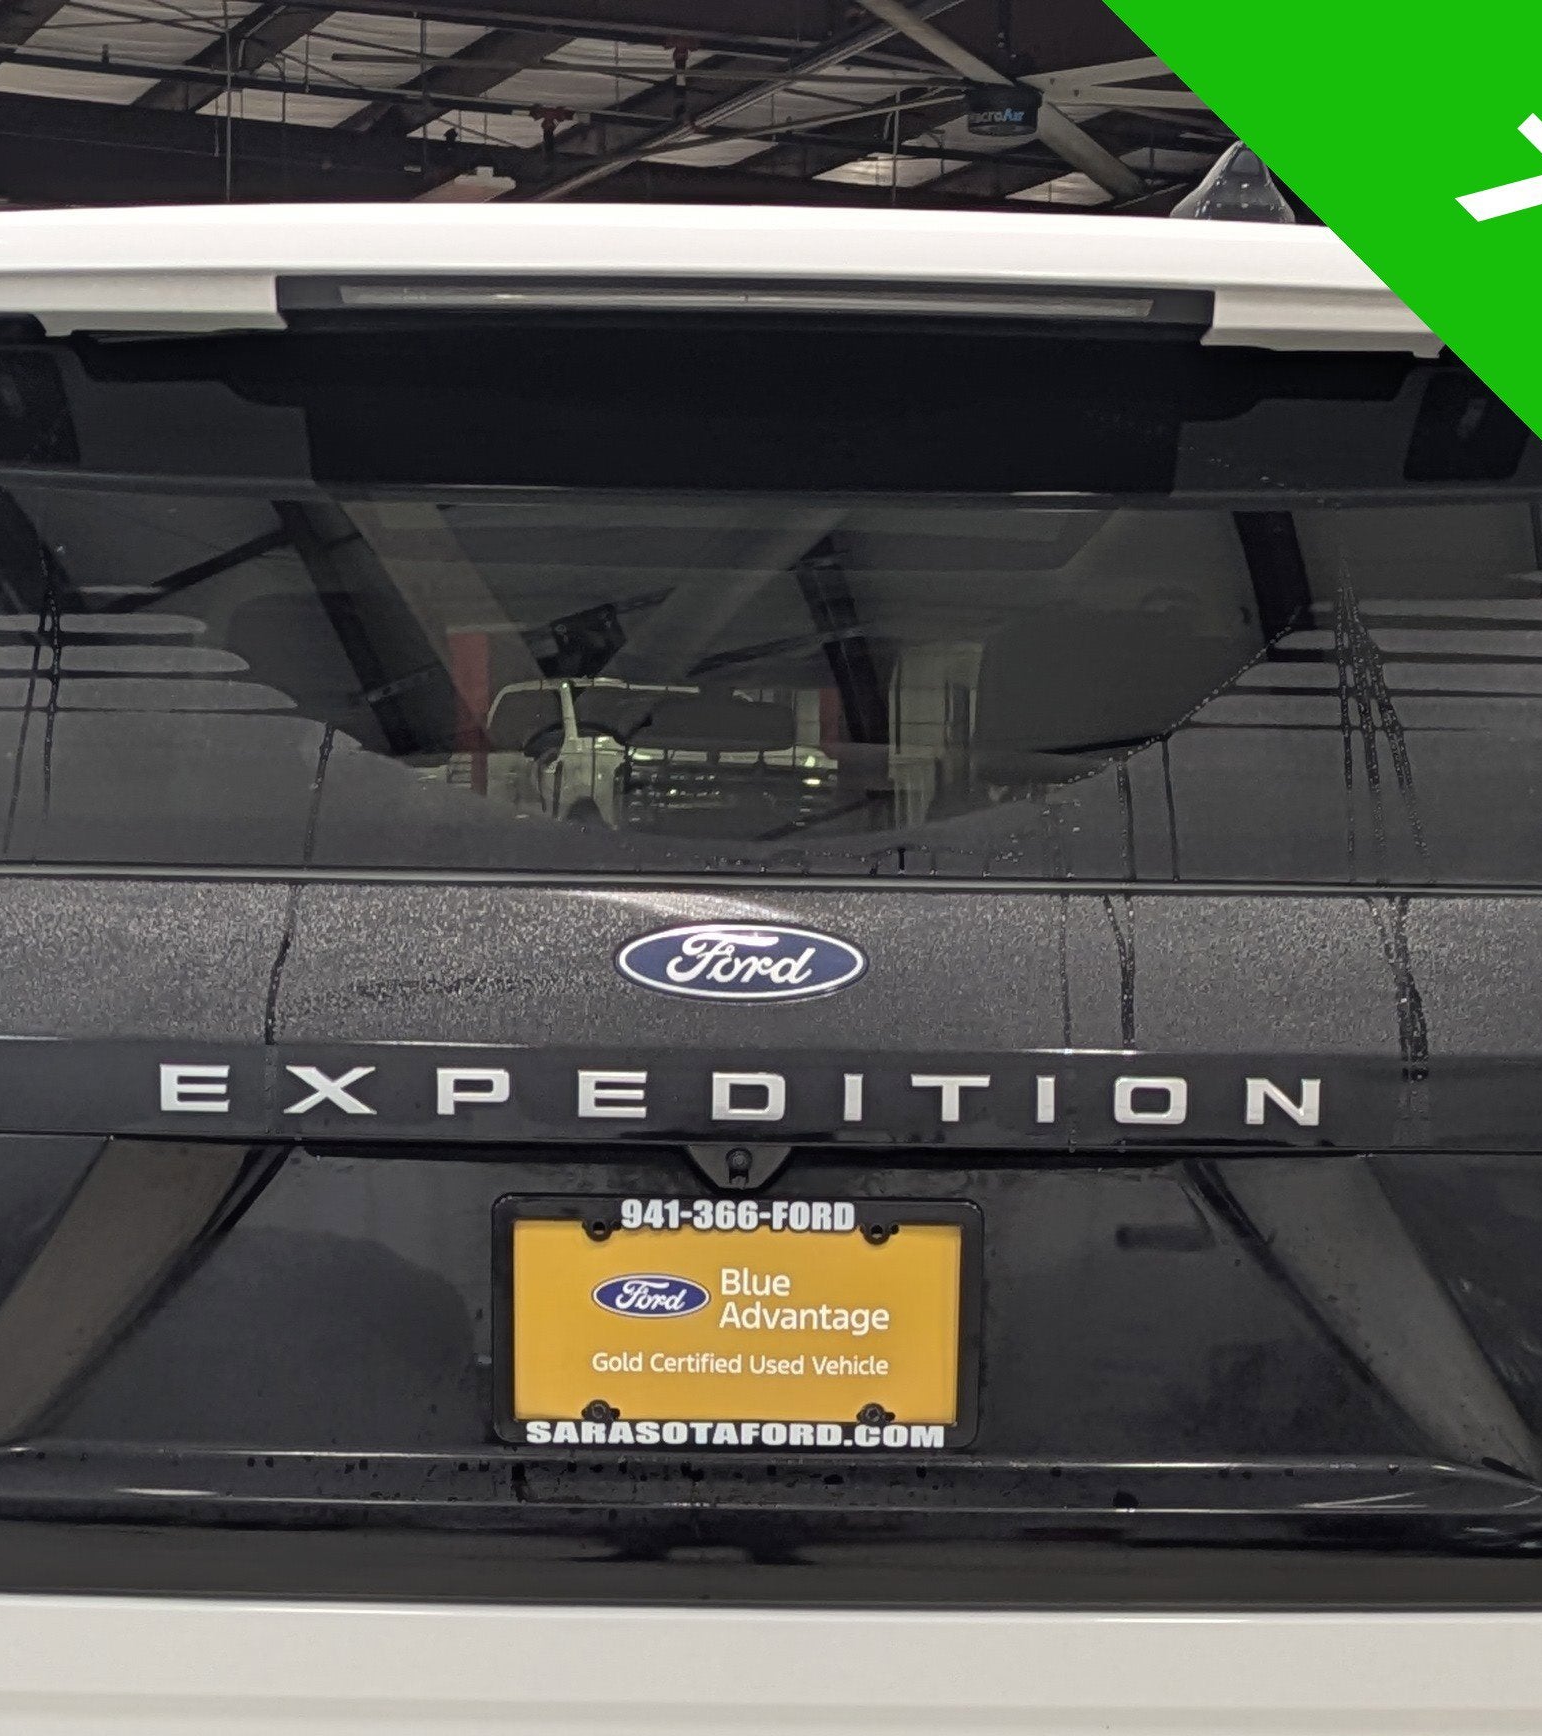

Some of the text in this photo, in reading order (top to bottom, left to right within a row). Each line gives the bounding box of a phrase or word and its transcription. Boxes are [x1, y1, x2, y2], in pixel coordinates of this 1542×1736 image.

[665, 930, 817, 985] Ford
[158, 1062, 1322, 1127] EXPEDITION
[620, 1197, 856, 1232] 941-366-FORD
[614, 1279, 688, 1311] Ford
[720, 1267, 792, 1298] Blue
[718, 1300, 891, 1337] Advantage
[591, 1351, 890, 1376] Gold Certified Used Vehicle
[525, 1420, 946, 1449] SARASOTAFORD.COM
